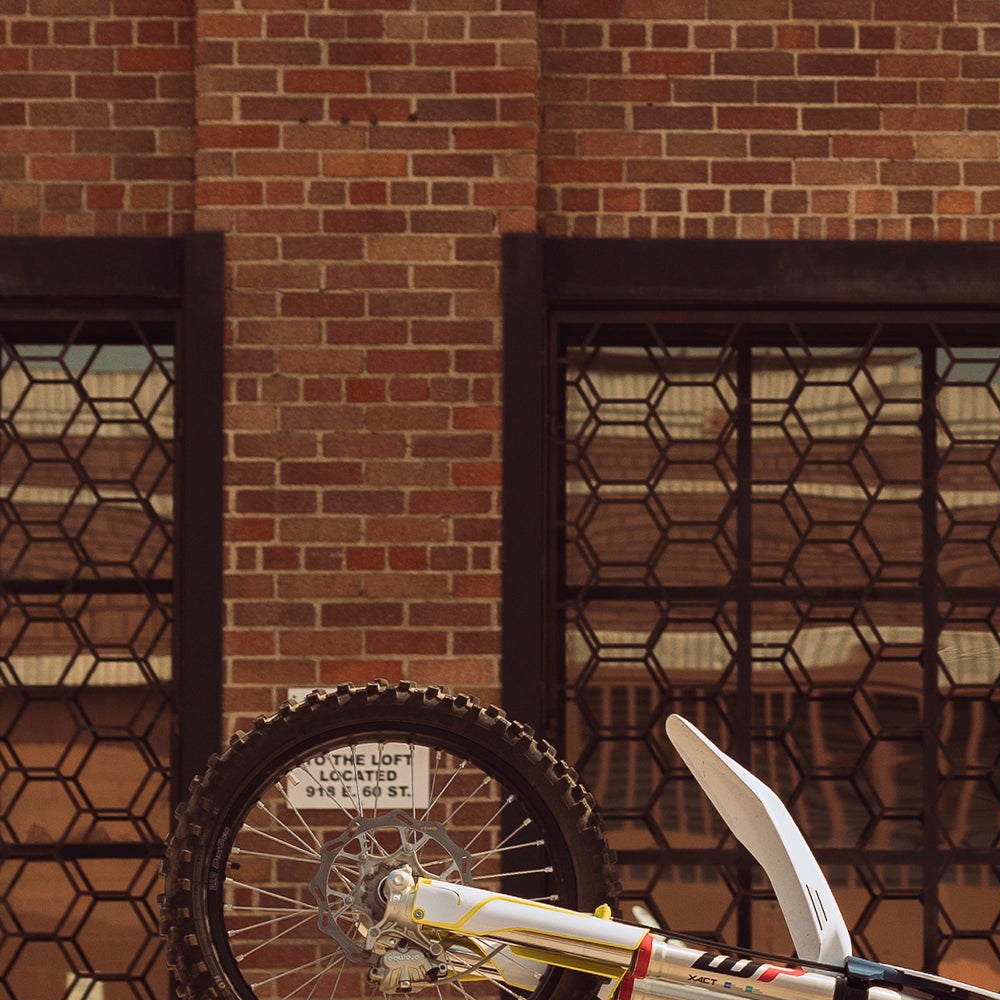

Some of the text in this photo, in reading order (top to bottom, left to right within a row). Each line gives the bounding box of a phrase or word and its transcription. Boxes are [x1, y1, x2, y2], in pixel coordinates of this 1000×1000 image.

[332, 754, 365, 766] THE
[371, 754, 413, 766] LOFT
[320, 770, 397, 781] LOCATED
[306, 786, 335, 798] 918
[362, 786, 382, 798] 60
[388, 786, 412, 797] ST.
[687, 974, 718, 986] XACT
